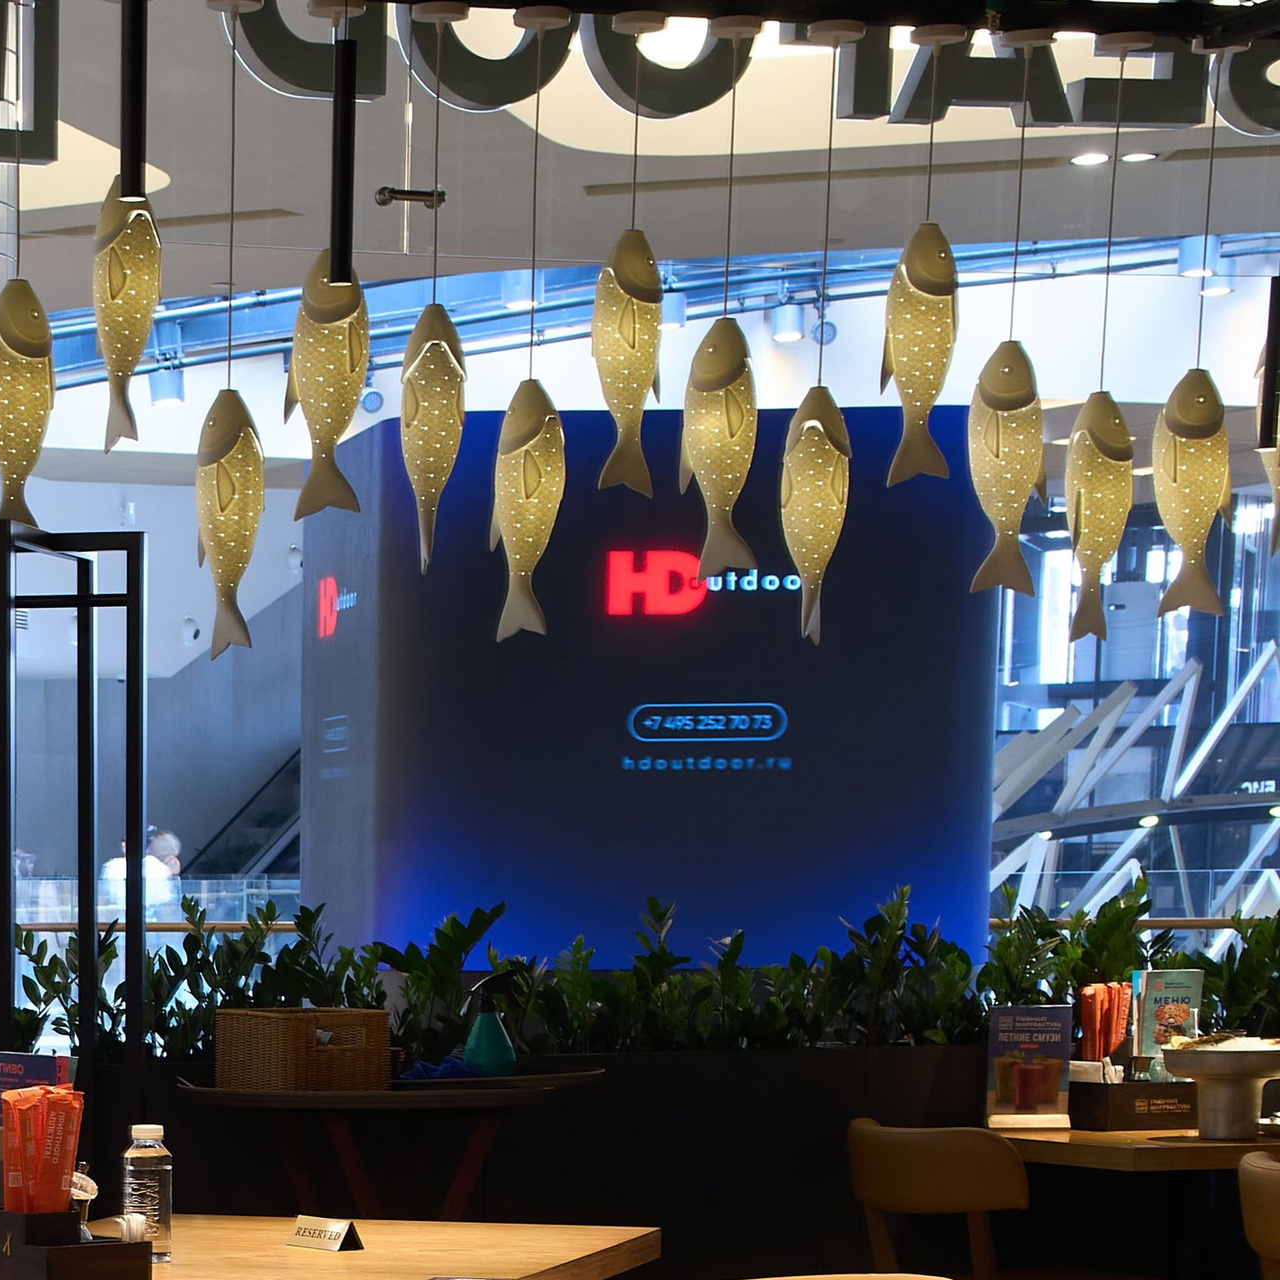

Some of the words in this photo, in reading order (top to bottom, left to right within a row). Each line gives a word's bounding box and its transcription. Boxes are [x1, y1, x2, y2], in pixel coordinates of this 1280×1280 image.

[607, 550, 708, 615] HD
[696, 715, 726, 730] 252
[728, 715, 751, 729] 70
[752, 714, 773, 729] 73
[622, 756, 792, 771] hdoutdoor.ru
[1153, 996, 1191, 1006] МЕНЮ
[999, 1032, 1030, 1042] ЛЕТНИЕ
[1033, 1032, 1061, 1042] СМУЗИ
[294, 1226, 341, 1241] RESERVED
